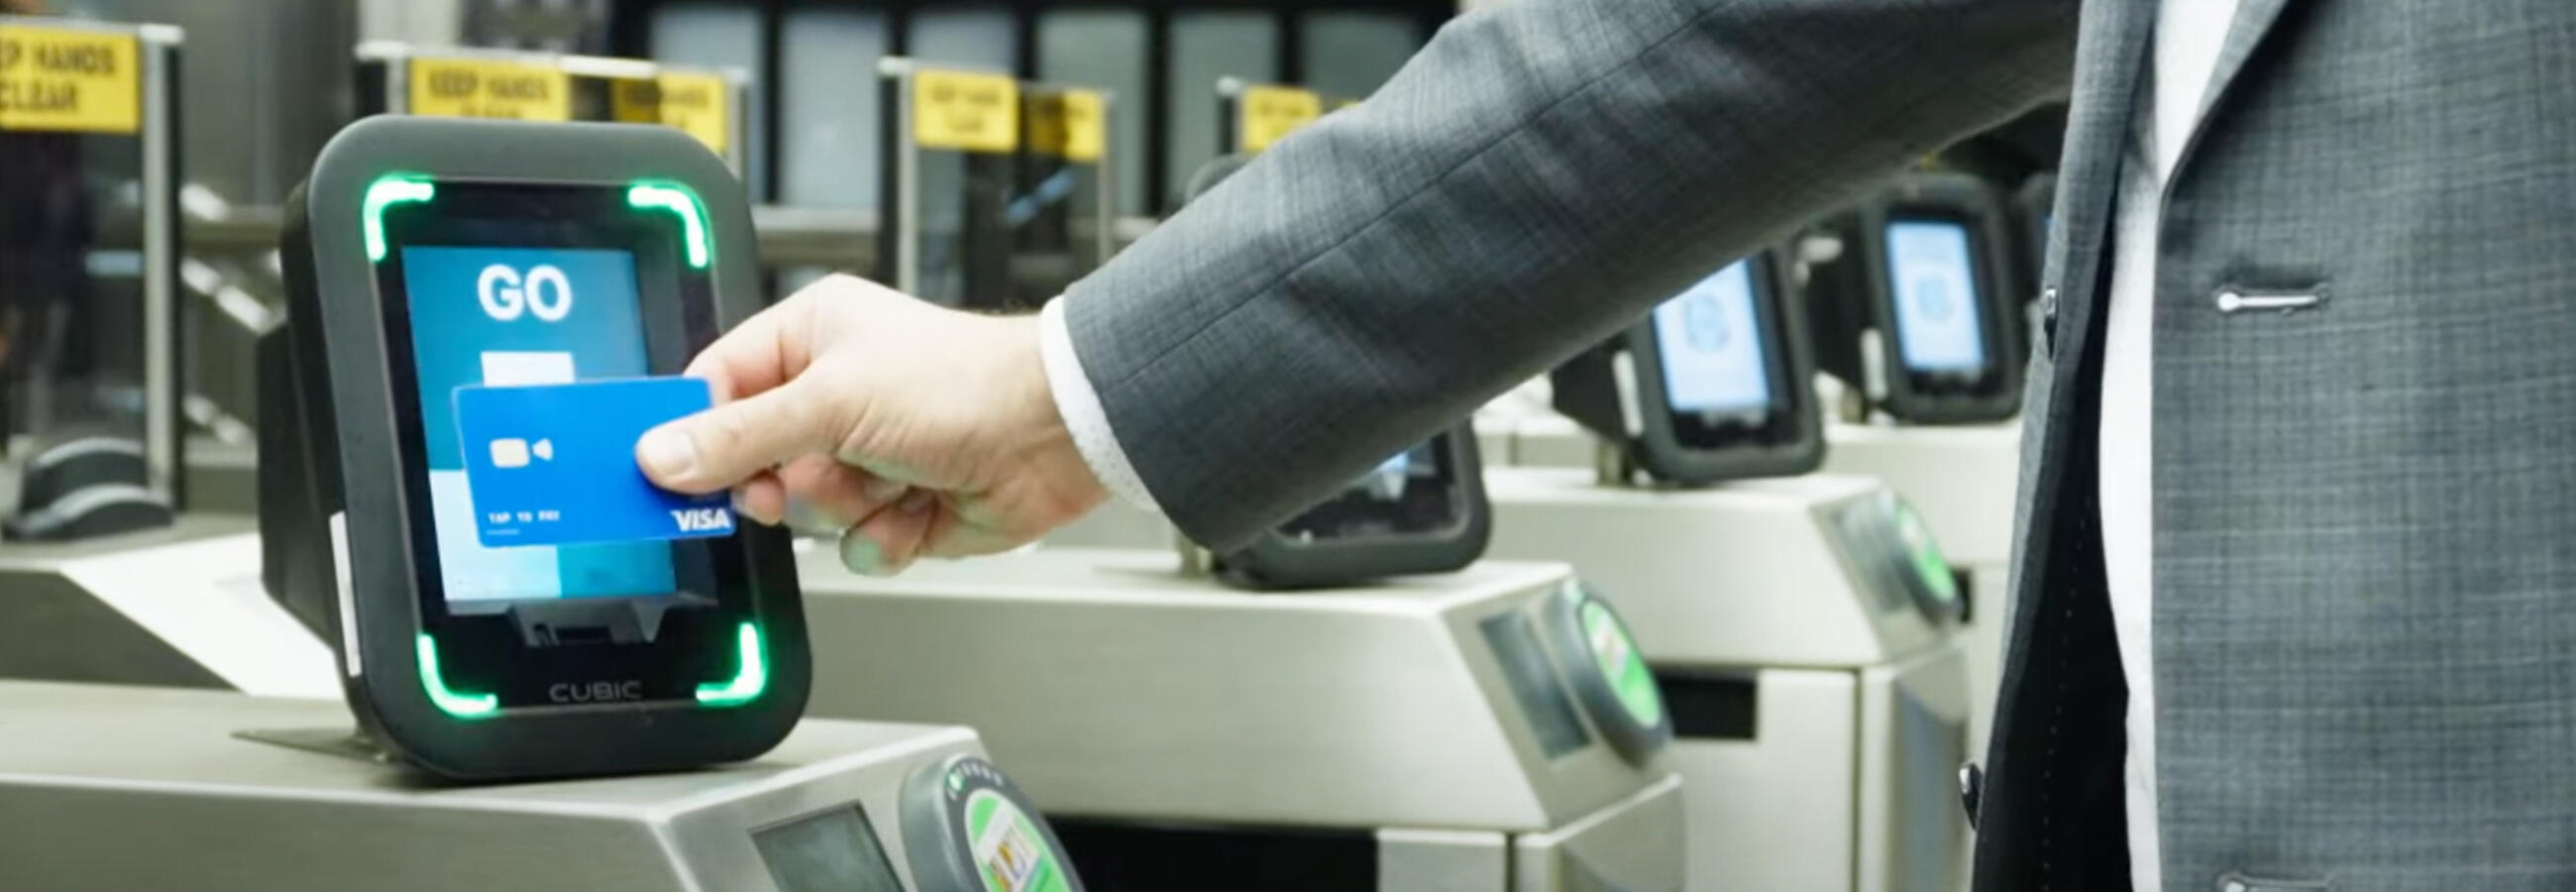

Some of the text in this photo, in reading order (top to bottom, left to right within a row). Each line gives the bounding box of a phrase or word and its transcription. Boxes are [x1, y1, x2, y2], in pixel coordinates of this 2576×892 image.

[39, 42, 117, 77] HANDS
[478, 264, 574, 322] GO
[671, 507, 731, 532] VISA
[549, 681, 643, 703] CUBIC
